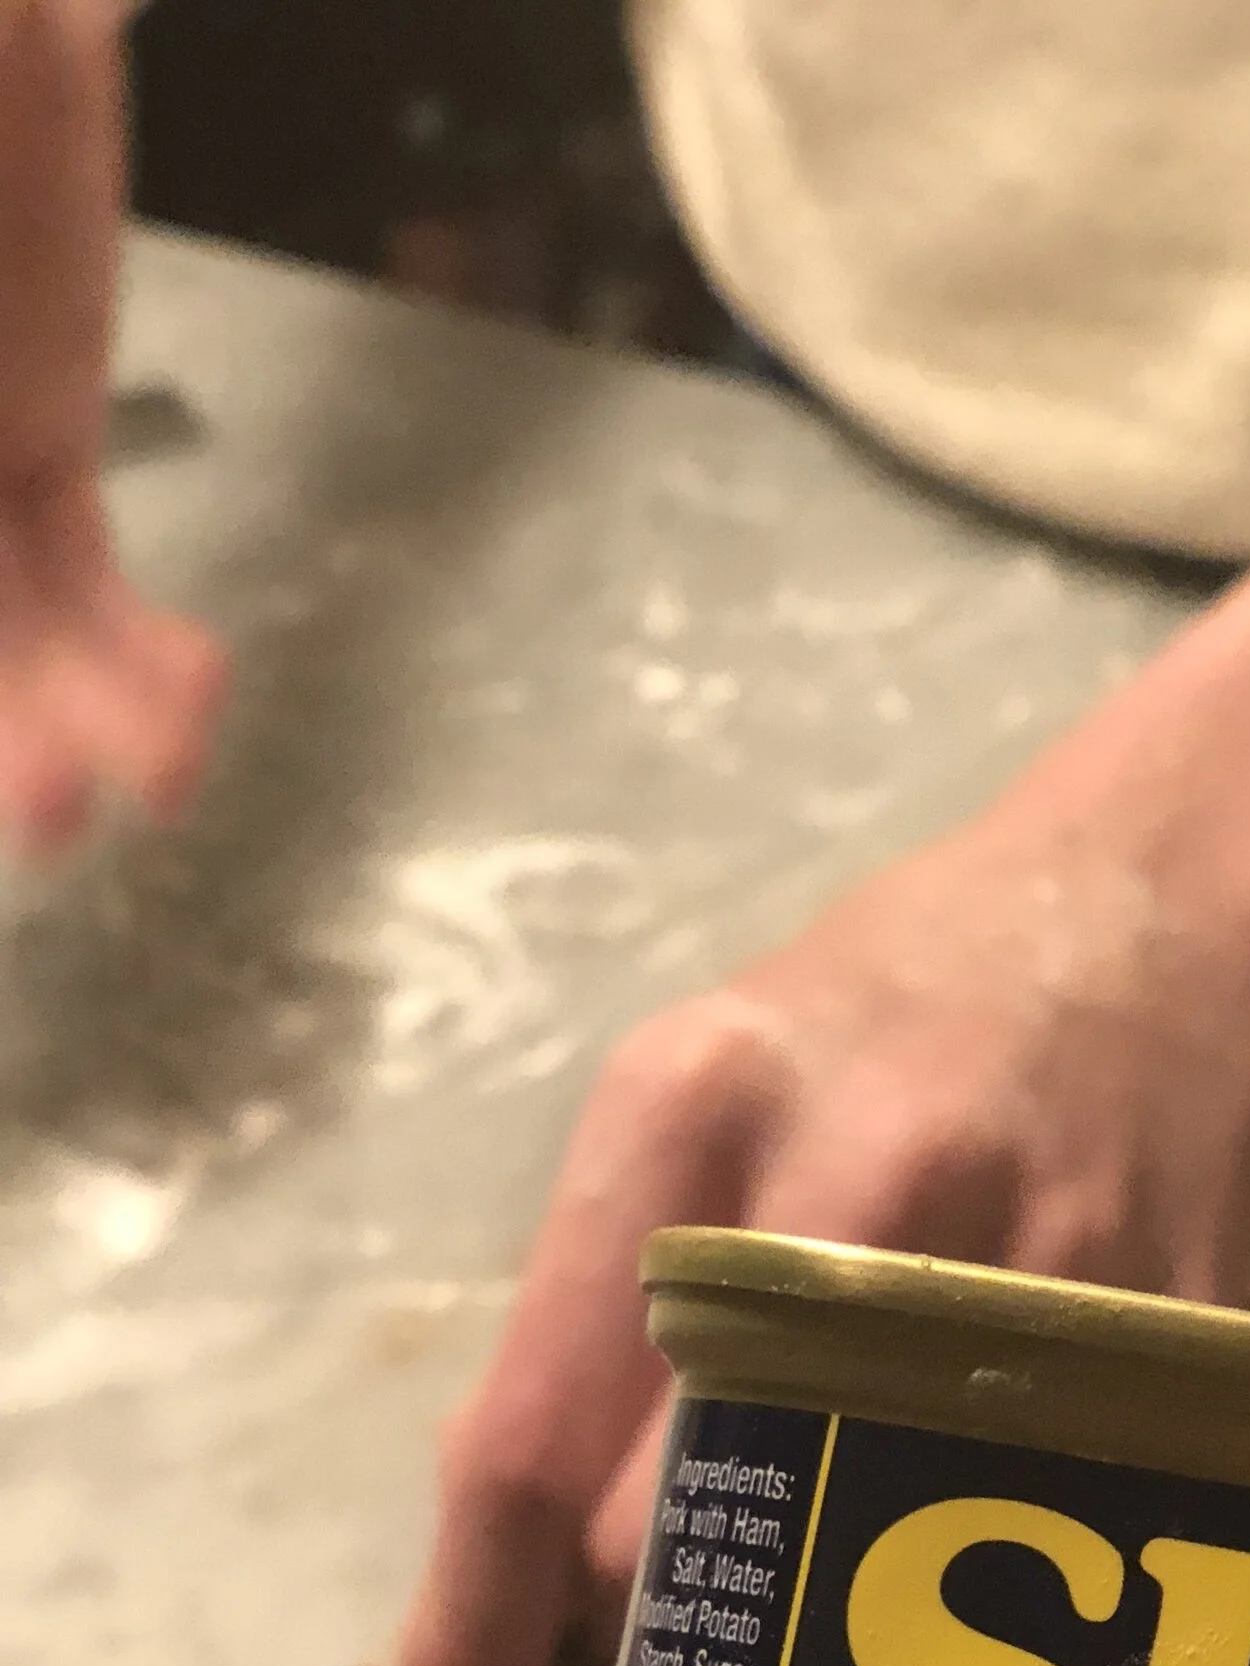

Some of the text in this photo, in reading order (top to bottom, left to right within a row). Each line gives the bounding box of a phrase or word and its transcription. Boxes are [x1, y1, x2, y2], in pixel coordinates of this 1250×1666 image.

[674, 1452, 794, 1501] Ingredients:
[690, 1501, 727, 1541] with
[731, 1506, 785, 1555] Ham,
[672, 1547, 776, 1604] Salt, Water,
[696, 1600, 761, 1645] Potato
